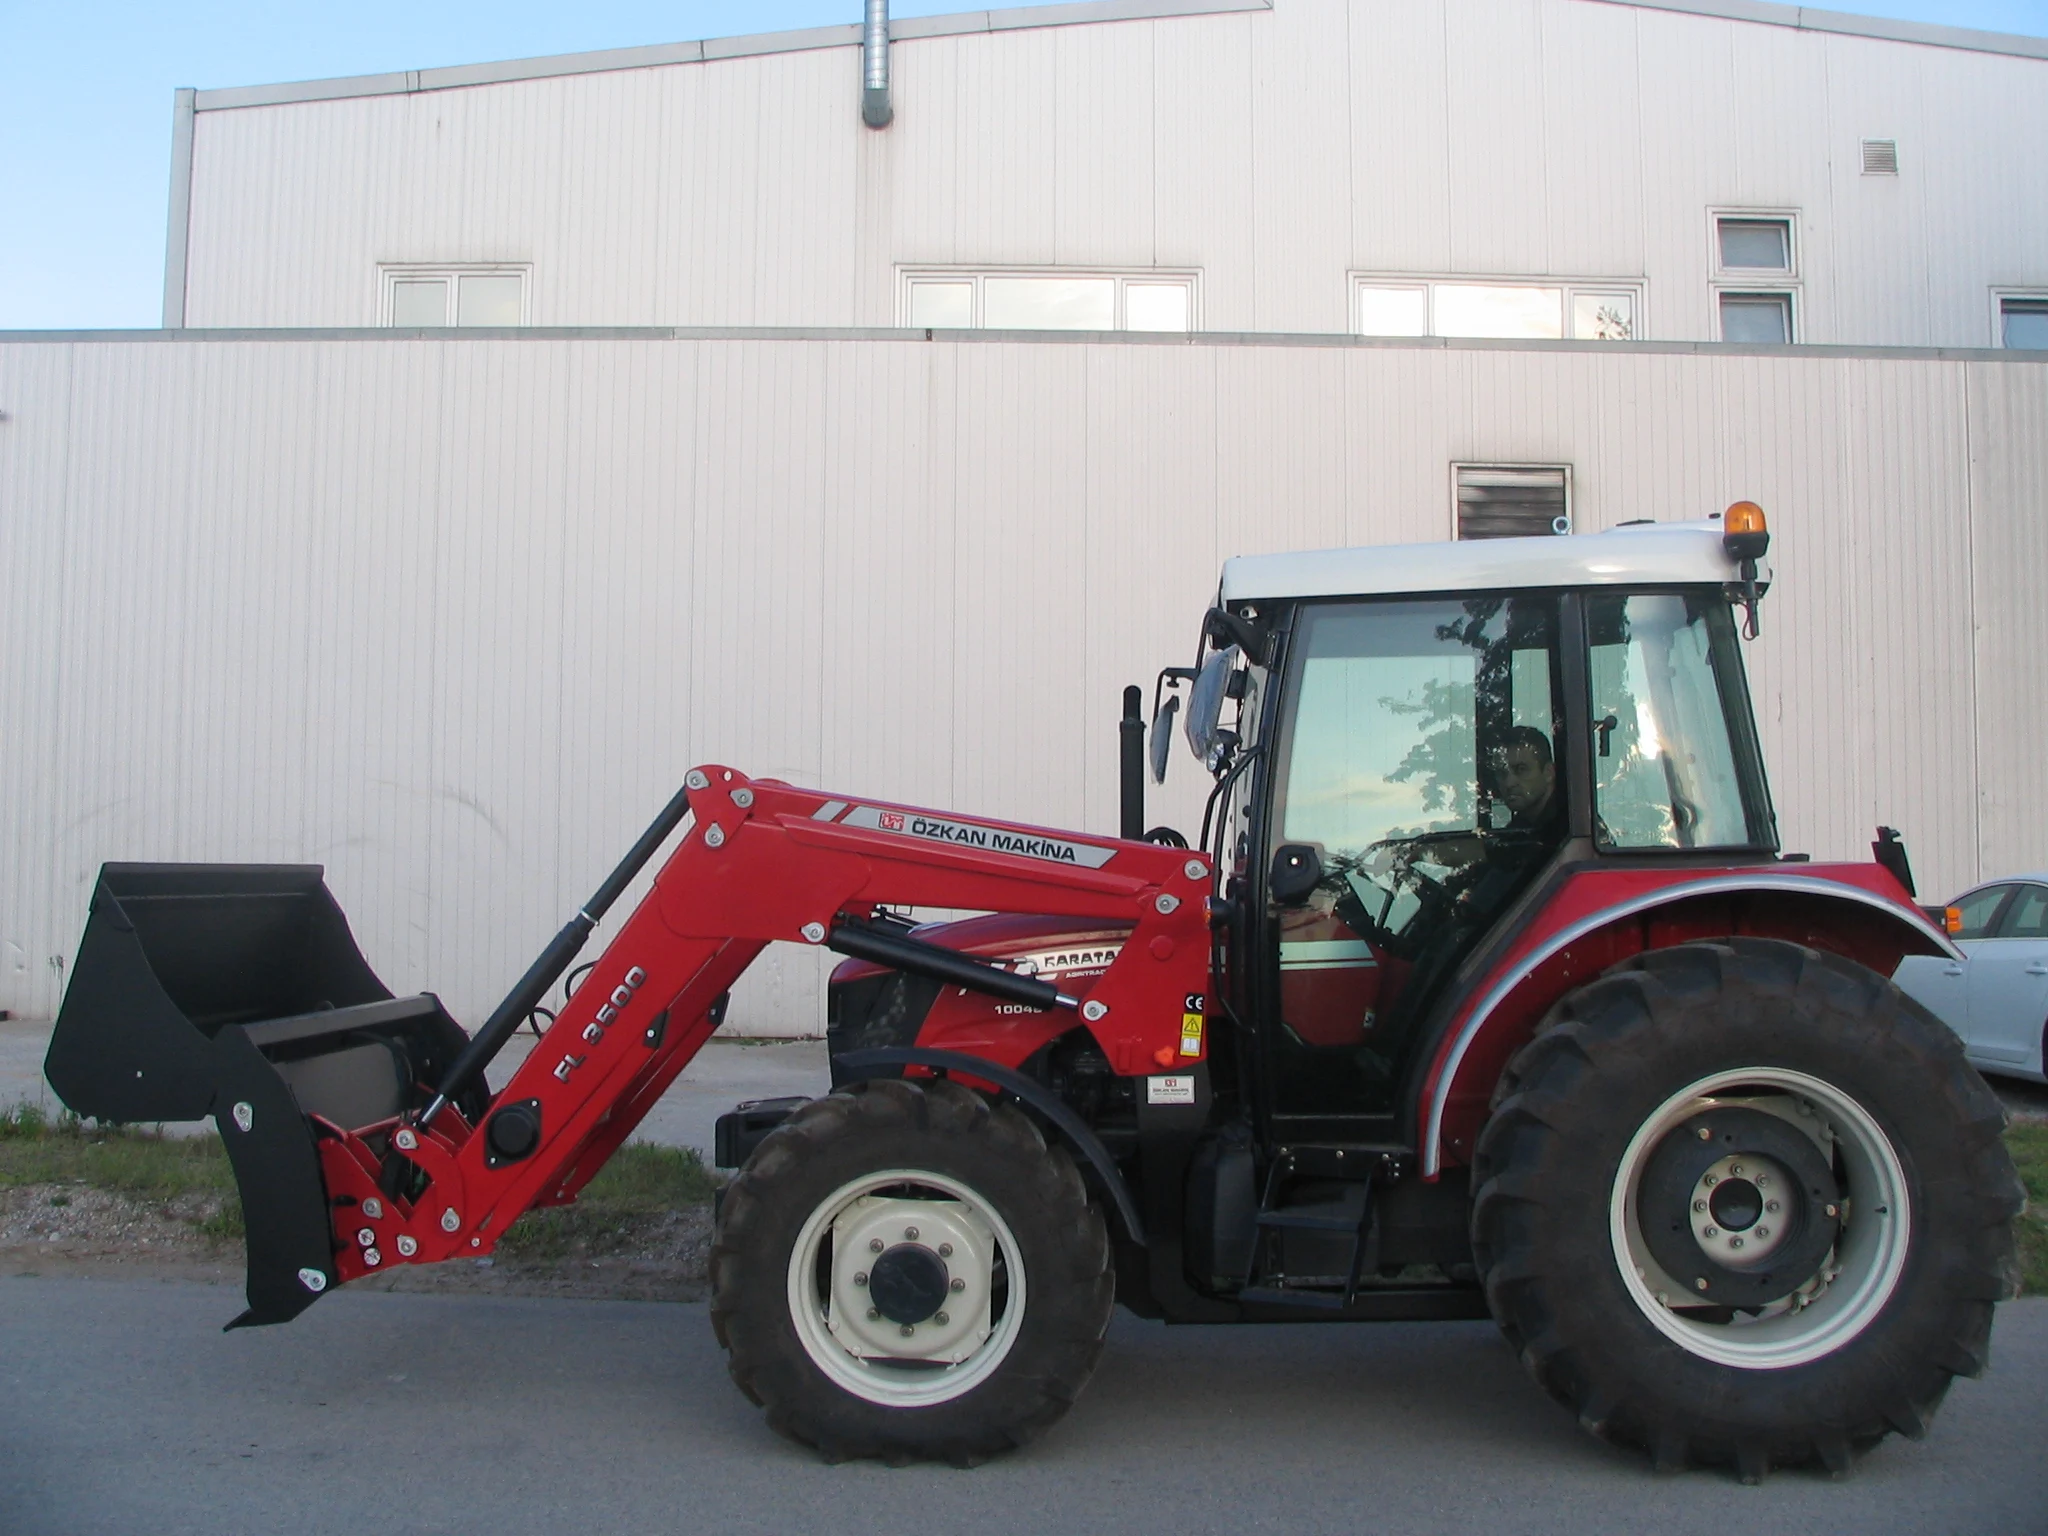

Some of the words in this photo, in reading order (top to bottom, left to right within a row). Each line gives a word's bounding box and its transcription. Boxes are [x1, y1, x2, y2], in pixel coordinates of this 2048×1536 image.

[912, 817, 986, 846] ÖZKAN
[991, 834, 1076, 862] MAKİNA
[553, 1054, 587, 1084] FL
[582, 965, 647, 1045] 3500
[1185, 995, 1204, 1010] CE
